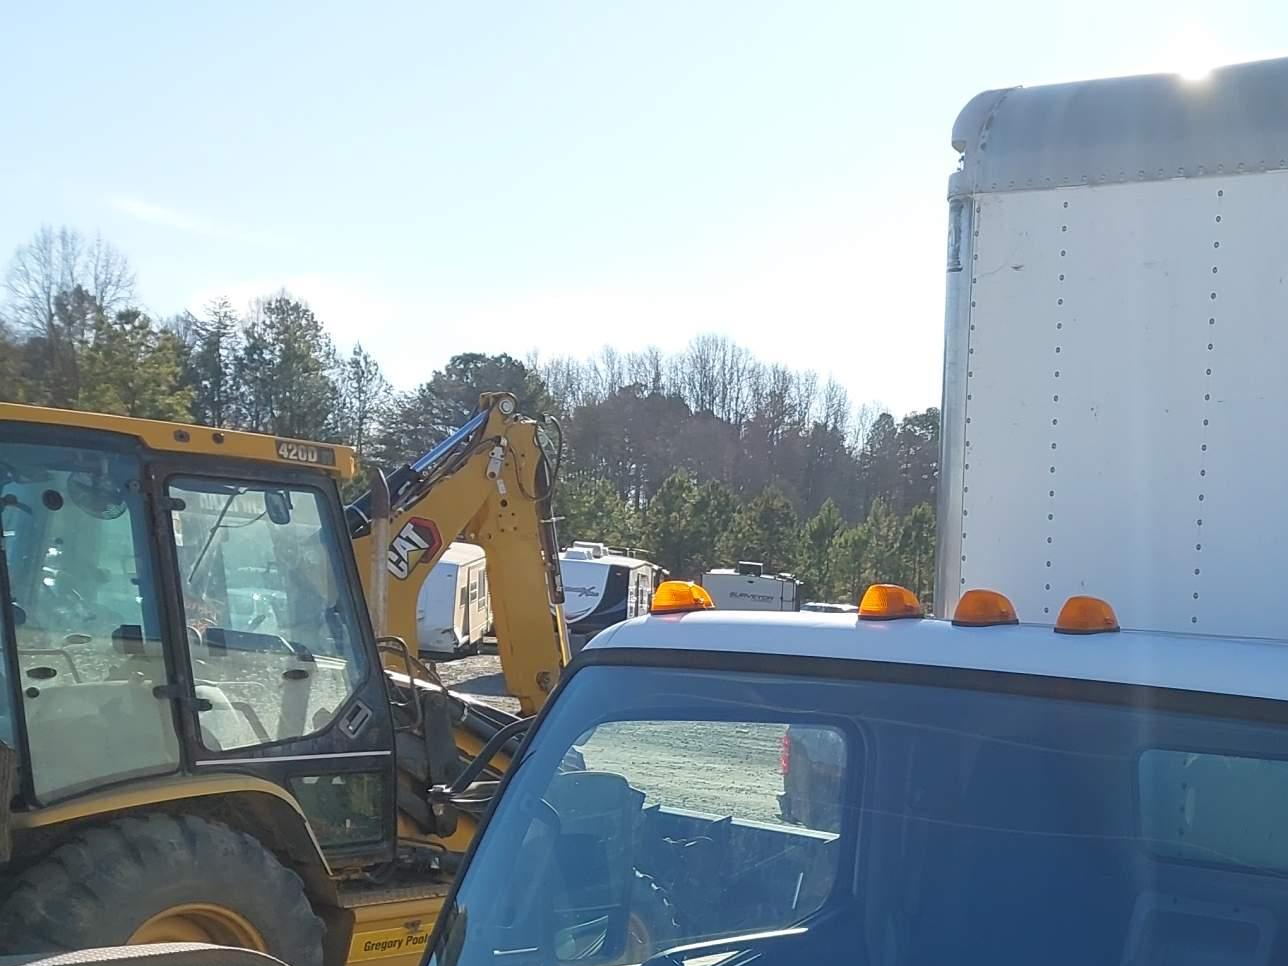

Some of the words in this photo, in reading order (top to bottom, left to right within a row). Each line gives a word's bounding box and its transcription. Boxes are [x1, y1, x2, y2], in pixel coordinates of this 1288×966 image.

[278, 442, 318, 462] 420D
[387, 522, 430, 579] CAT
[363, 938, 403, 952] Gregory
[405, 933, 431, 946] Pool
